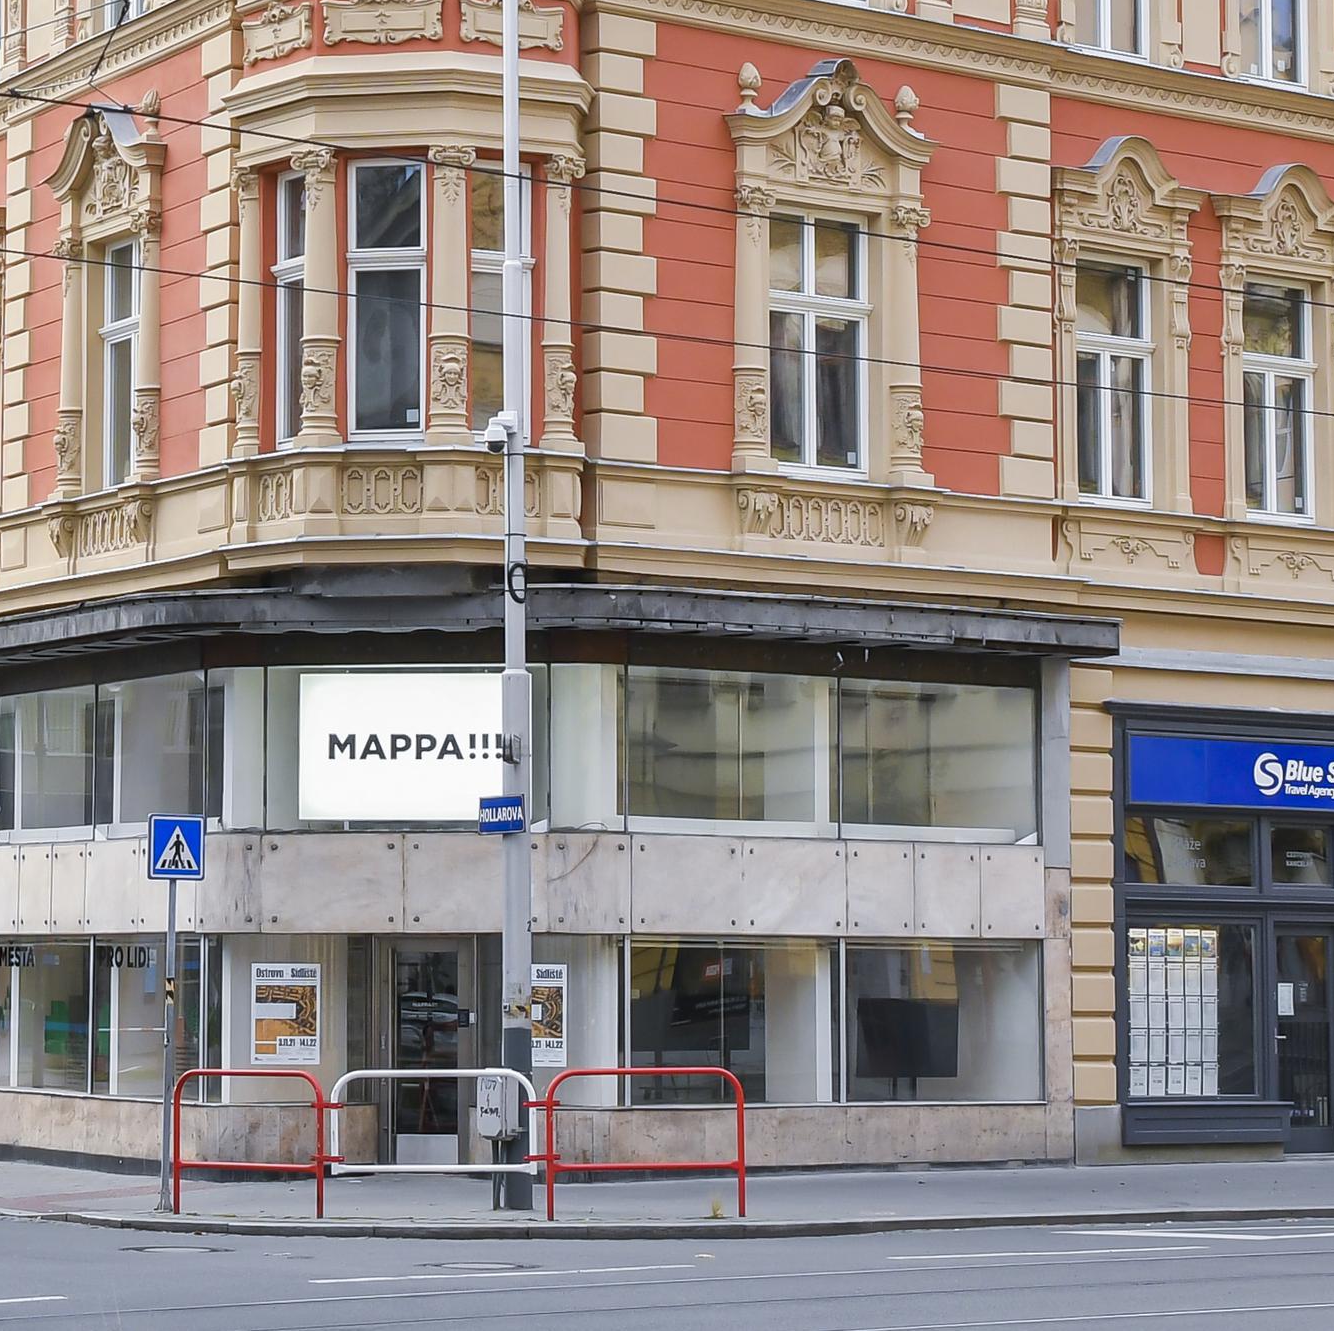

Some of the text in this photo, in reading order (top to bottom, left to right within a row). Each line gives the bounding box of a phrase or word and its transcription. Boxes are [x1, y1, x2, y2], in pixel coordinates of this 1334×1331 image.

[328, 734, 503, 760] MAPPA!!!
[1285, 759, 1323, 782] Blue
[1284, 783, 1308, 795] Travel
[480, 806, 524, 823] HOLLAROVA
[0, 941, 35, 968] MĚSTA
